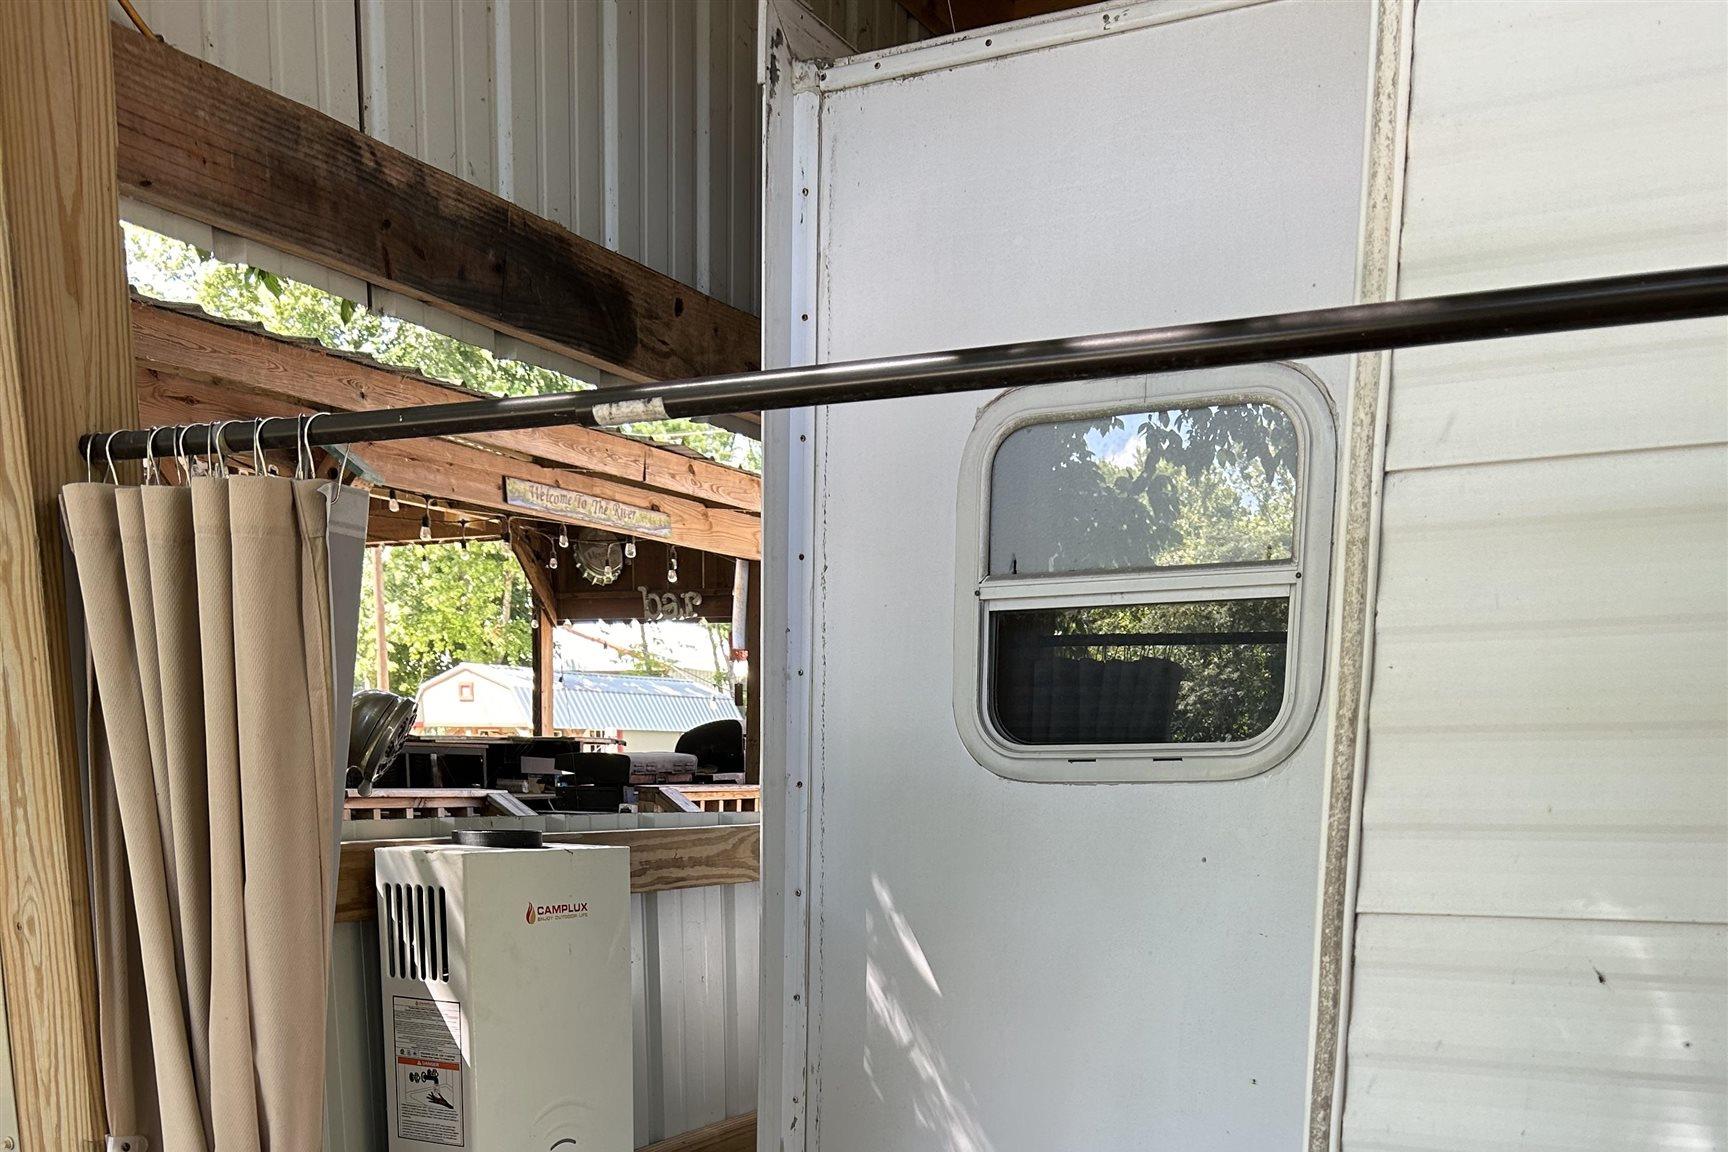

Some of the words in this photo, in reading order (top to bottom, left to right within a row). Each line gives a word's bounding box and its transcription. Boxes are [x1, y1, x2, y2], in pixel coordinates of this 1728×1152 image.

[528, 485, 572, 506] Welcome
[575, 493, 587, 510] To
[592, 499, 609, 516] The
[612, 503, 637, 521] River
[637, 586, 703, 620] bar
[537, 902, 588, 915] CAMPLUX
